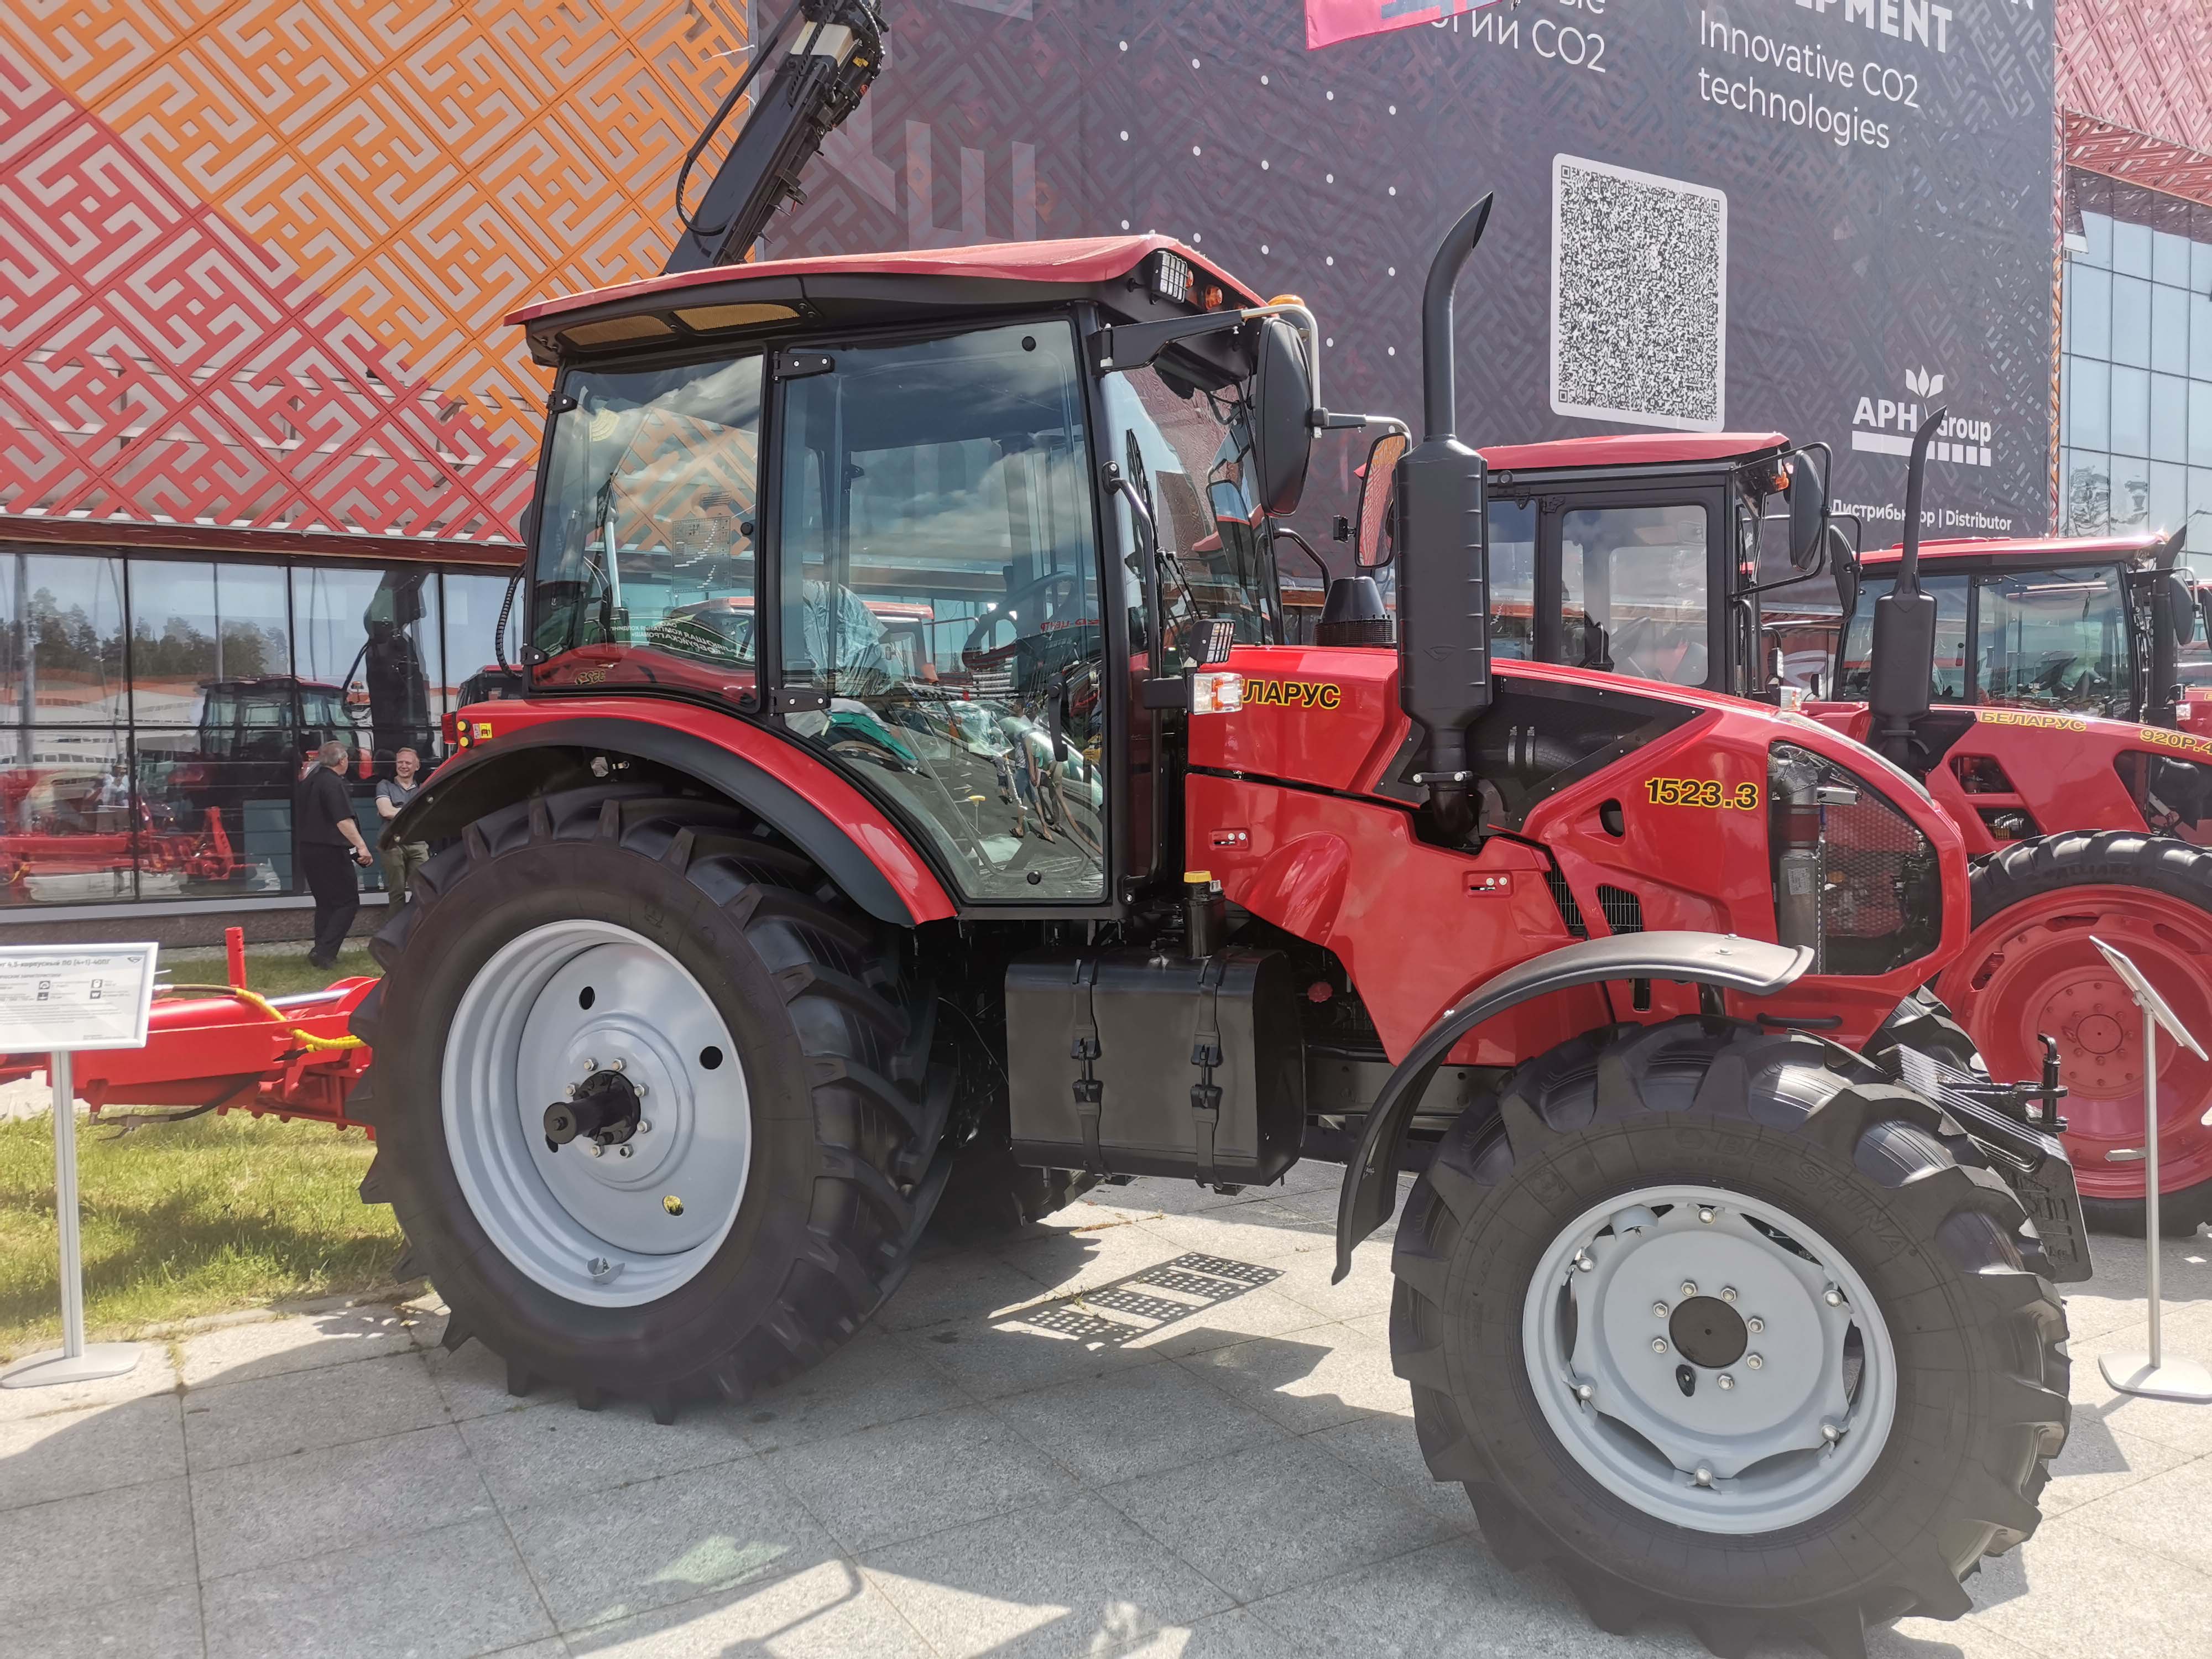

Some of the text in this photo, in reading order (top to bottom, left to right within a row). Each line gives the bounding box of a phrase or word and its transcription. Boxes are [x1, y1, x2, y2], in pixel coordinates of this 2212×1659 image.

[1532, 19, 1606, 73] CO2
[1698, 9, 1921, 108] Innovative CO2
[1698, 67, 1890, 149] technologies
[1852, 397, 1991, 446] APH Group
[1833, 499, 1936, 528] Дистрибьор
[1946, 510, 2012, 531] Distributor
[1240, 679, 1340, 709] ЛАРУС
[1980, 711, 2087, 732] БЕЛАРУС
[1645, 777, 1759, 810] 1523.3
